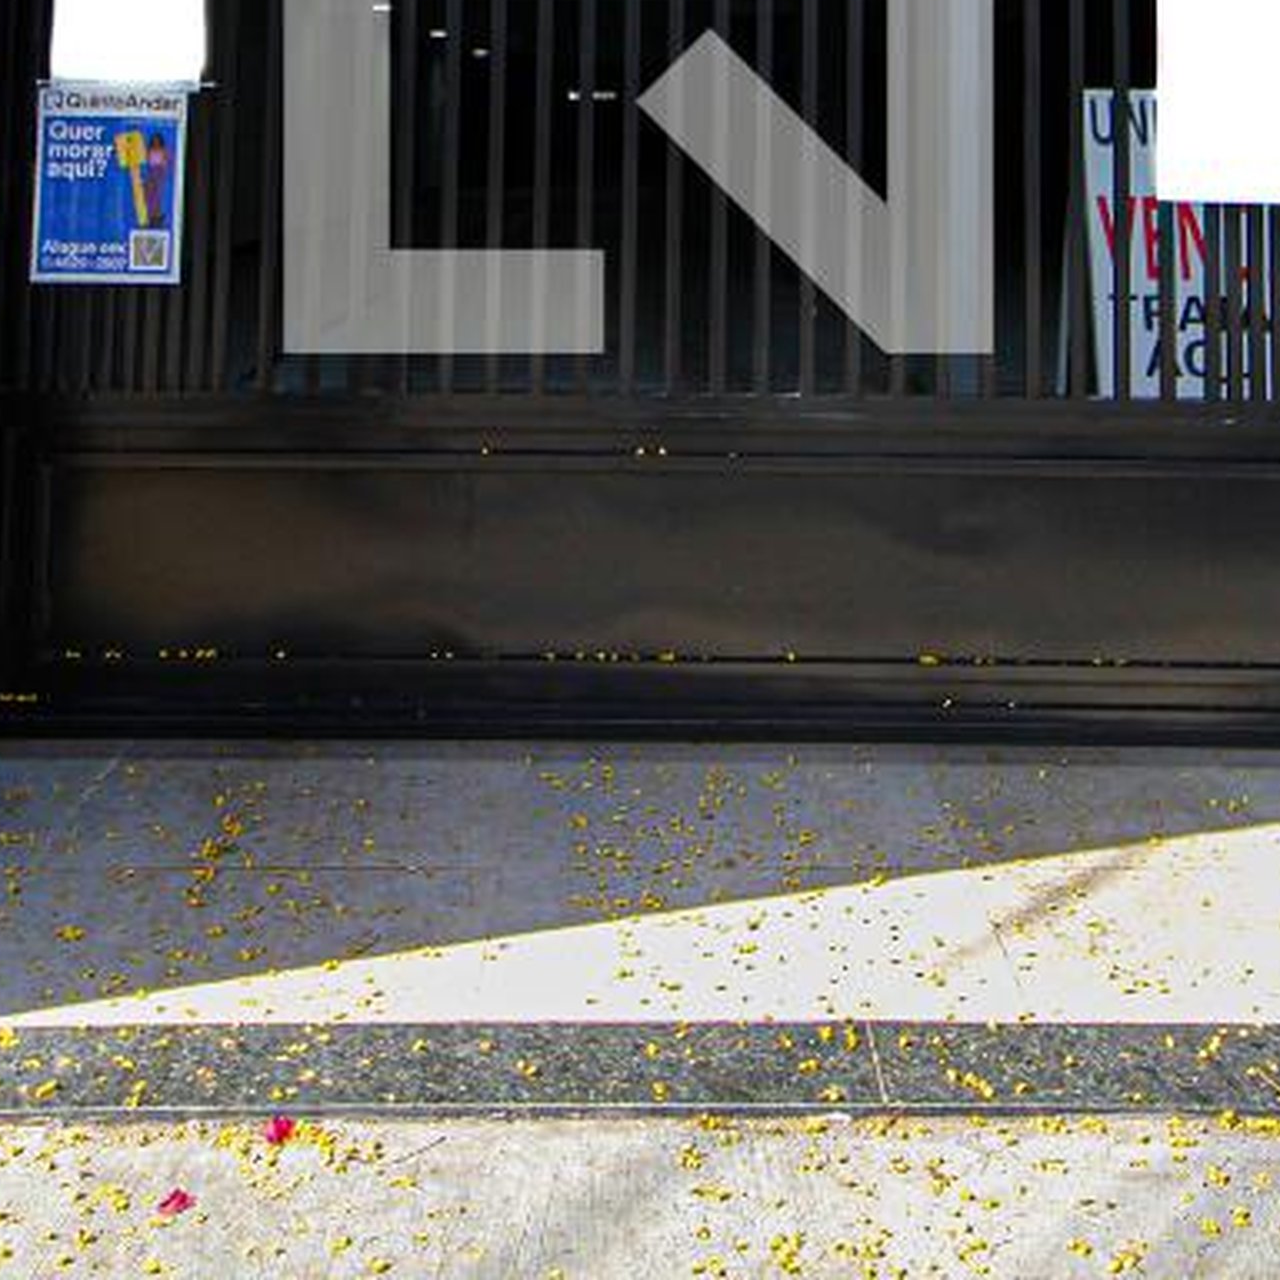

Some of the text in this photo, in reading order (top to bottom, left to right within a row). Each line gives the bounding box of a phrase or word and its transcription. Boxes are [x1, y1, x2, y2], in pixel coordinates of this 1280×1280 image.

[48, 120, 106, 141] Quer
[47, 142, 114, 160] morar
[46, 158, 108, 180] aqui?
